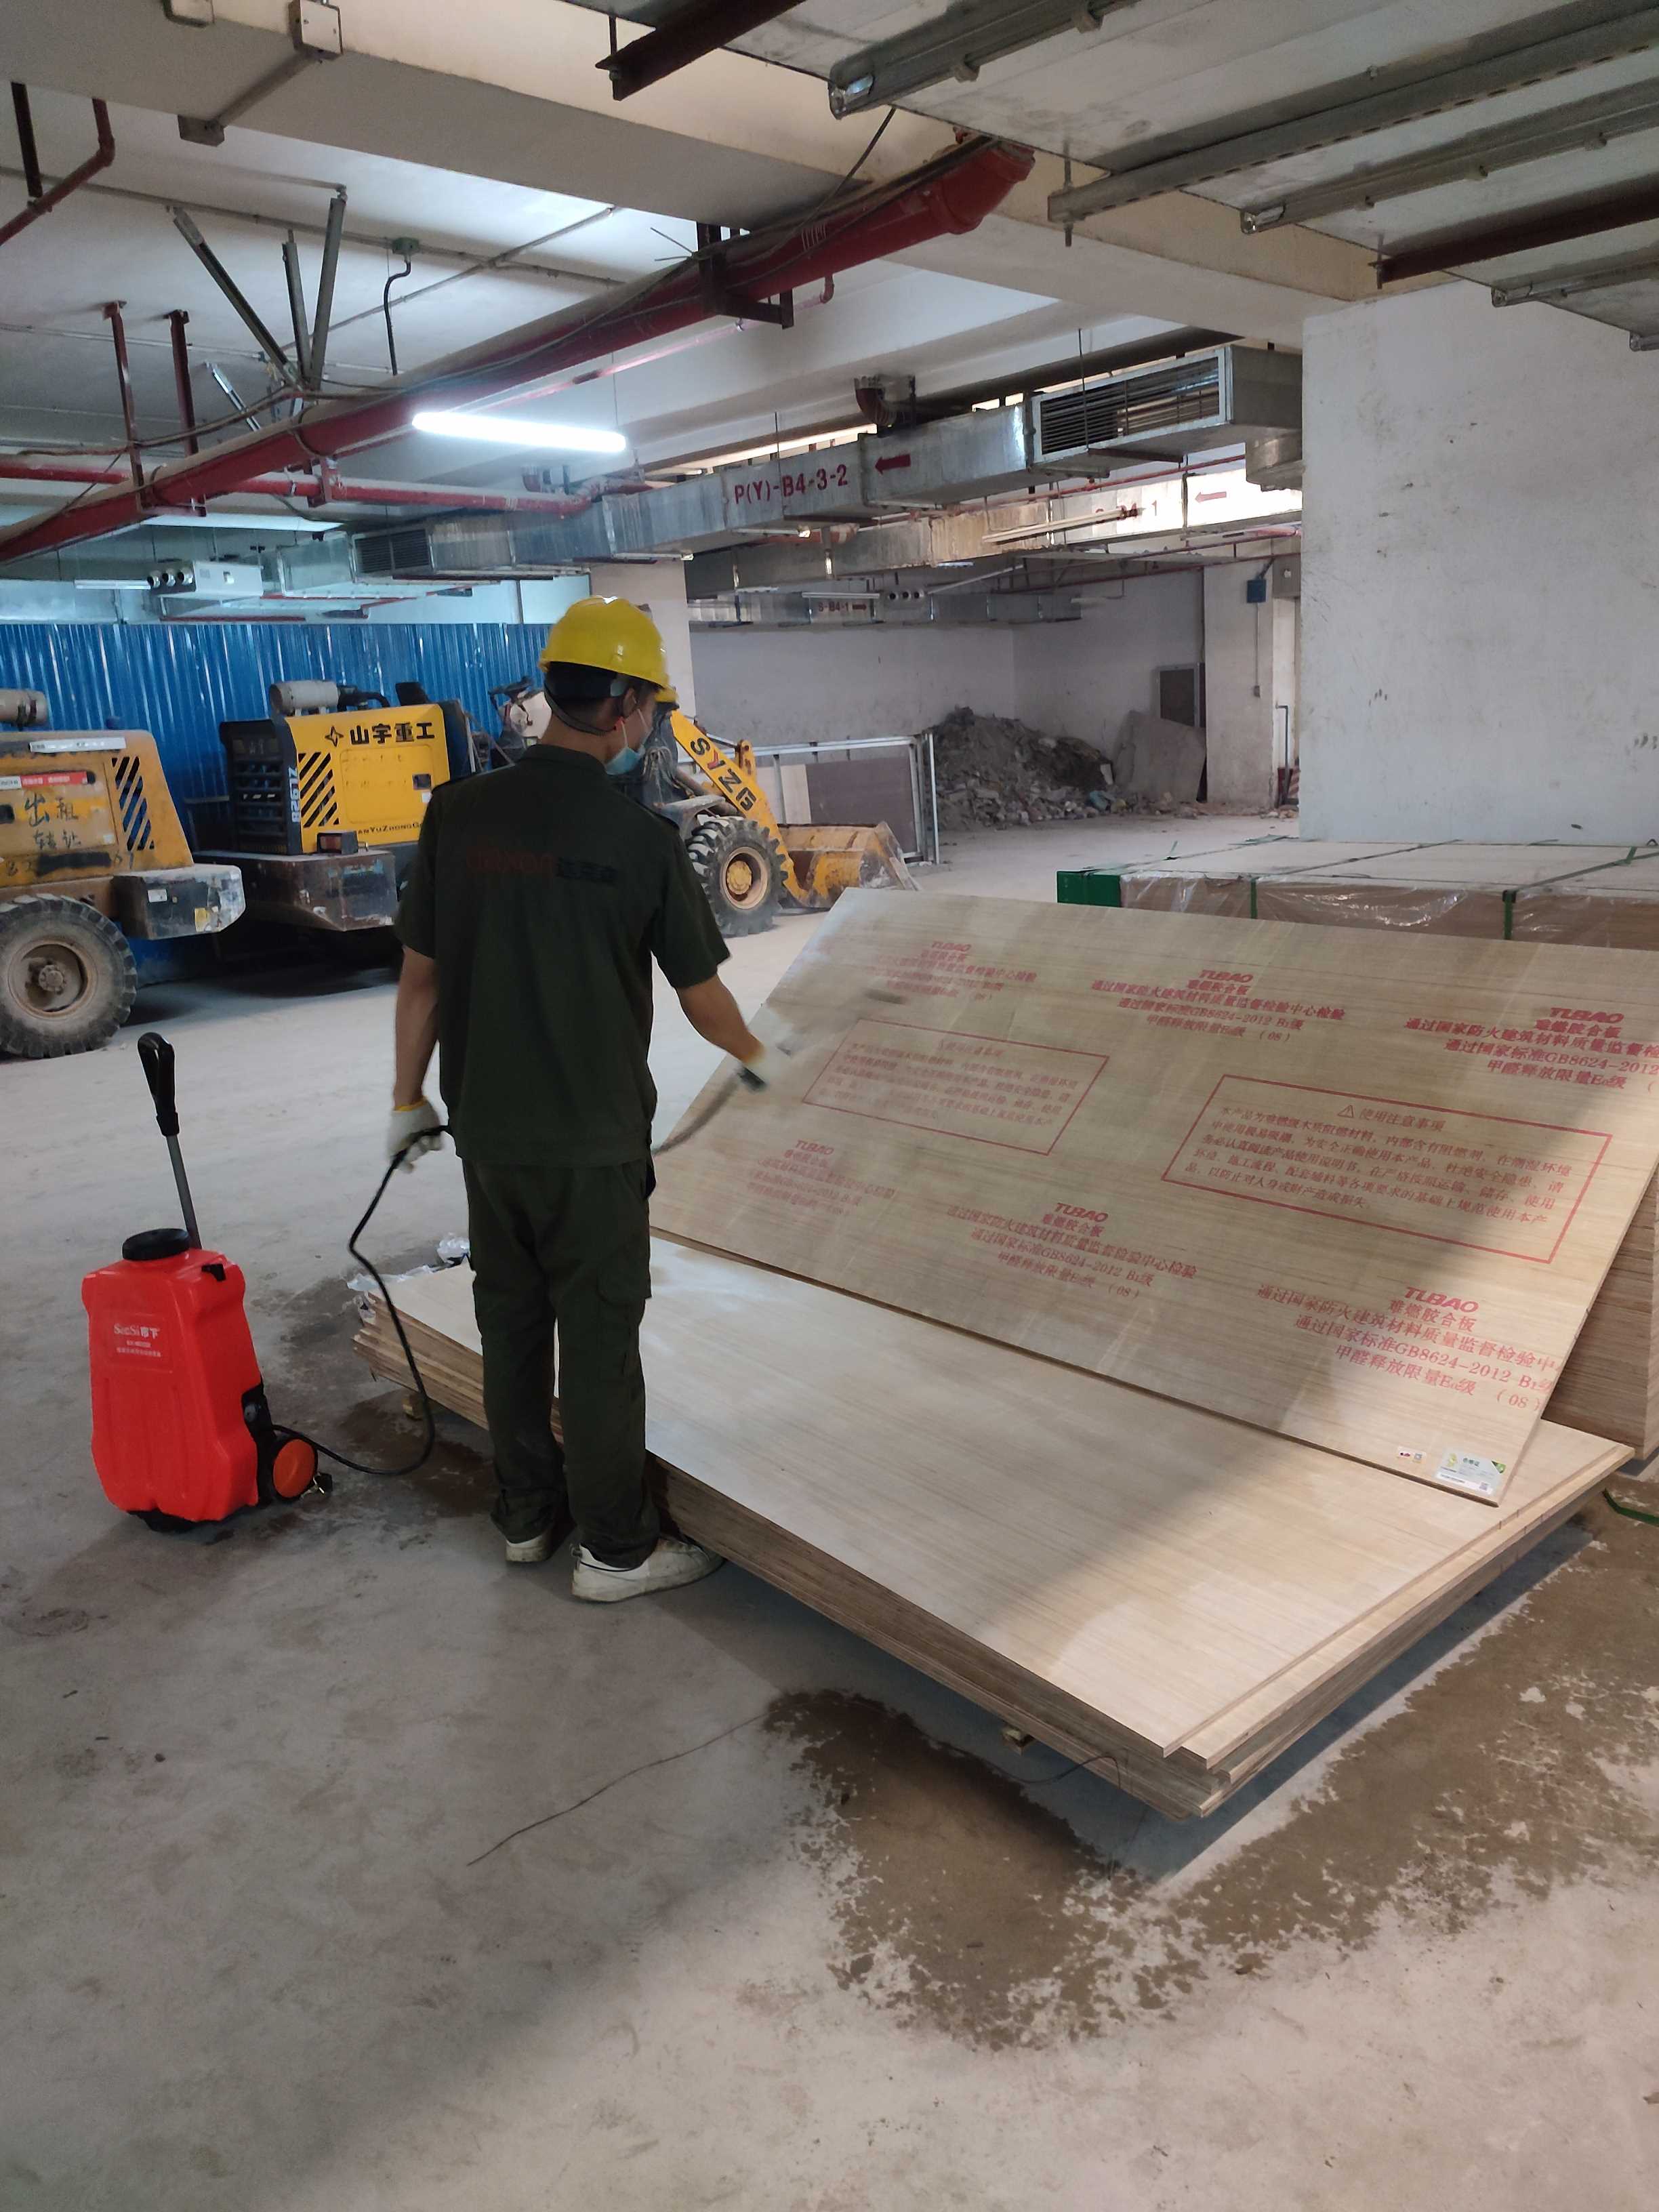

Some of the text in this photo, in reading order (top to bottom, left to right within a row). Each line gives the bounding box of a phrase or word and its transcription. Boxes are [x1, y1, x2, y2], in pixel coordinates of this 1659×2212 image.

[734, 464, 848, 504] P(Y)-B4-3-2
[350, 722, 434, 745] 山宇重工
[690, 737, 757, 812] SYZG
[1257, 1283, 1561, 1372] 通过国家防火建筑材料质量监督检验中
